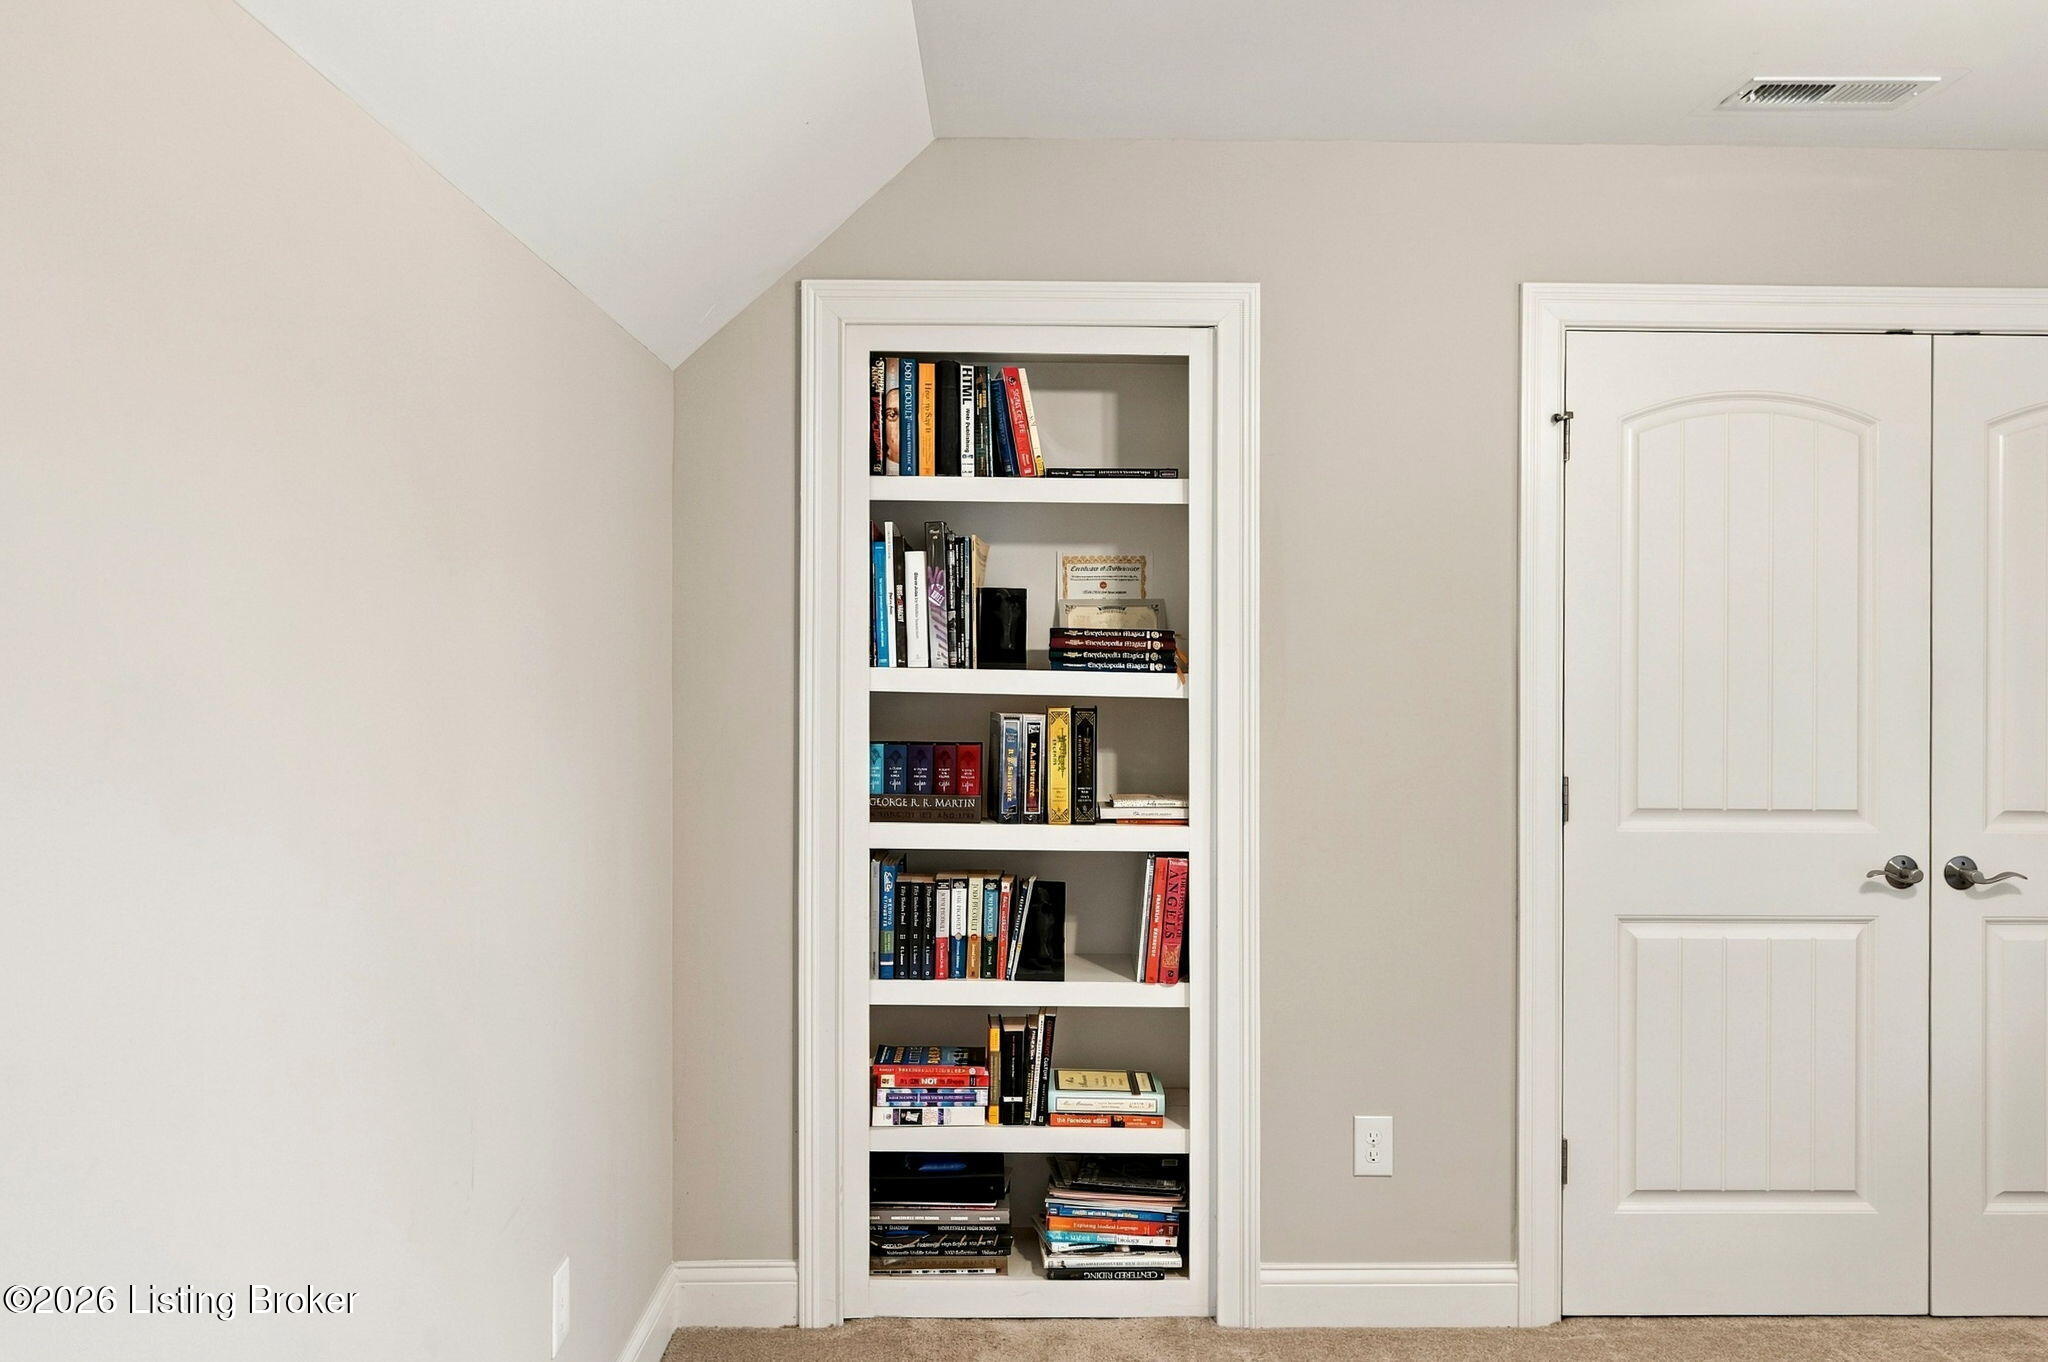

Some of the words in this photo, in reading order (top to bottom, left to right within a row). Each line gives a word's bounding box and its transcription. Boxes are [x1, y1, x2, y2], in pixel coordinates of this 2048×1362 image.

[875, 360, 885, 393] STEPHEN
[903, 361, 912, 381] JODI
[962, 367, 973, 405] HTML
[904, 384, 913, 421] PICOULT
[1084, 630, 1122, 638] Encyclopedia
[1083, 651, 1121, 659] Encyclopedia
[1087, 661, 1125, 669] Encyclopedia
[1126, 662, 1149, 670] Magica
[1006, 766, 1014, 802] Salvatore
[1029, 760, 1037, 798] Salvatore
[869, 797, 908, 807] GEORGE
[911, 798, 920, 807] R.
[923, 798, 932, 807] R.
[934, 798, 976, 808] MARTIN
[971, 883, 979, 900] JODI
[1164, 869, 1179, 939] ANGELS
[971, 901, 979, 931] PICOULT
[1042, 1057, 1050, 1081] CULTURE
[1093, 1117, 1109, 1125] effect
[1072, 1222, 1097, 1230] Exploring
[1083, 1271, 1113, 1279] RIDING
[1114, 1271, 1158, 1279] CENTERED
